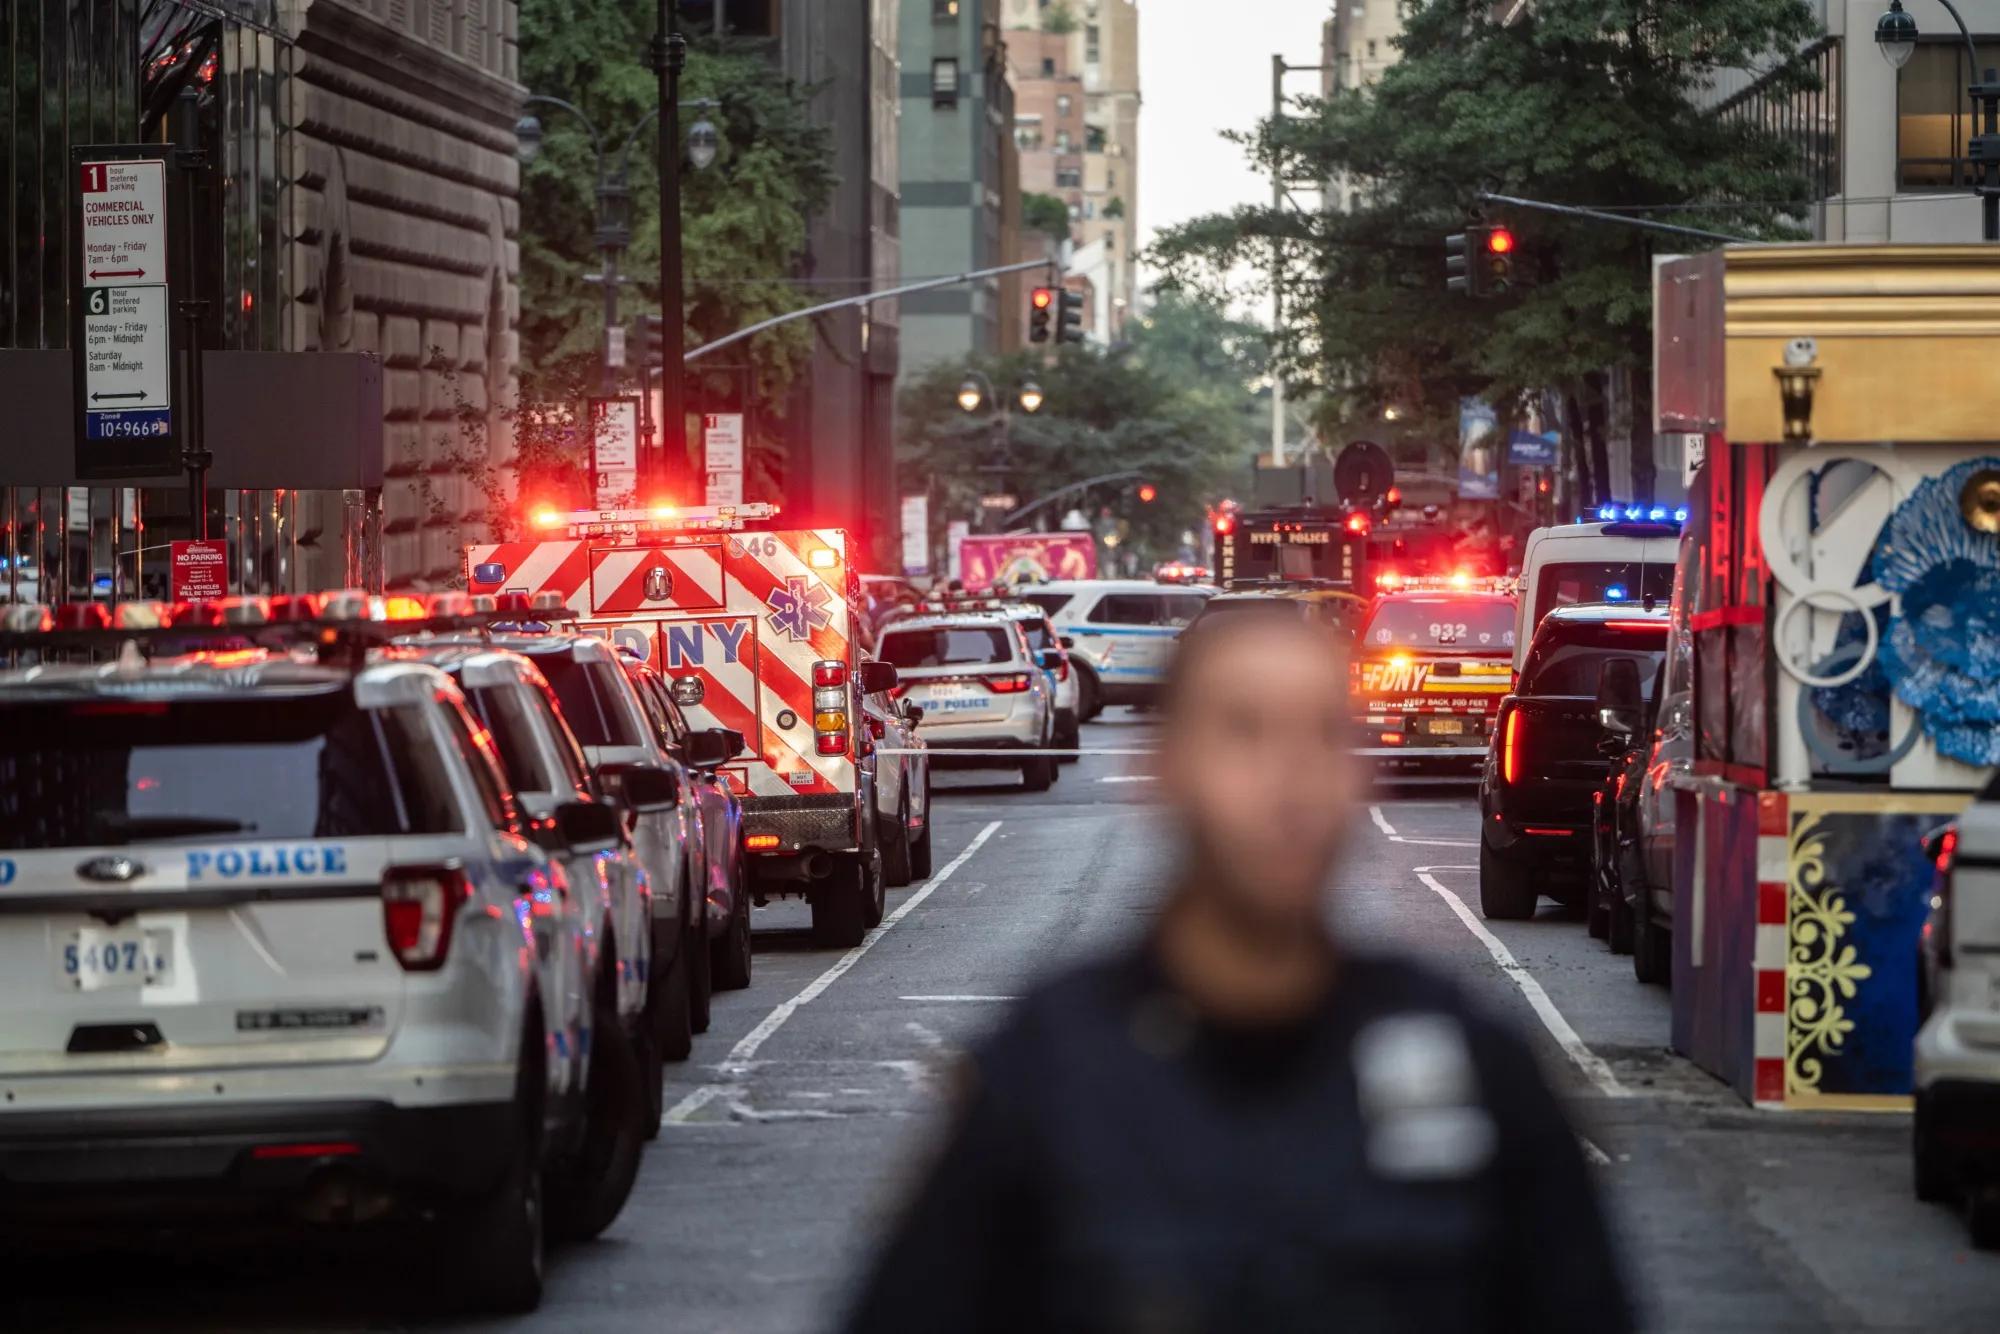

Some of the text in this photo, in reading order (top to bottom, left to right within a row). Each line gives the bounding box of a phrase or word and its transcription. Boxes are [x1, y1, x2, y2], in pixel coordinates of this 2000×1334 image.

[89, 166, 98, 190] 1
[110, 174, 138, 182] metered
[110, 182, 135, 192] parking
[86, 201, 144, 213] COMMERCIAL
[86, 214, 154, 226] VEHICLES ONLY
[87, 243, 116, 254] Monday
[124, 241, 147, 252] Friday
[88, 255, 103, 264] 7am
[111, 255, 129, 264] 6pm
[90, 290, 105, 314] 6
[112, 297, 140, 305] metered
[112, 305, 137, 314] parking
[88, 323, 117, 334] Monday
[125, 322, 148, 333] Friday
[88, 335, 107, 345] 6pm
[113, 334, 144, 345] Midnight
[89, 351, 122, 362] Saturday
[89, 363, 106, 372] 8am
[112, 361, 143, 372] Midnight
[1289, 532, 1329, 544] POLICE
[177, 553, 222, 562] NO PARKING
[1429, 623, 1467, 638] 932
[581, 622, 748, 667] DNY
[1369, 664, 1428, 692] FDNY
[944, 698, 990, 709] POLICE
[1428, 698, 1449, 707] BACK
[1469, 699, 1489, 707] FEET
[186, 846, 346, 879] POLICE
